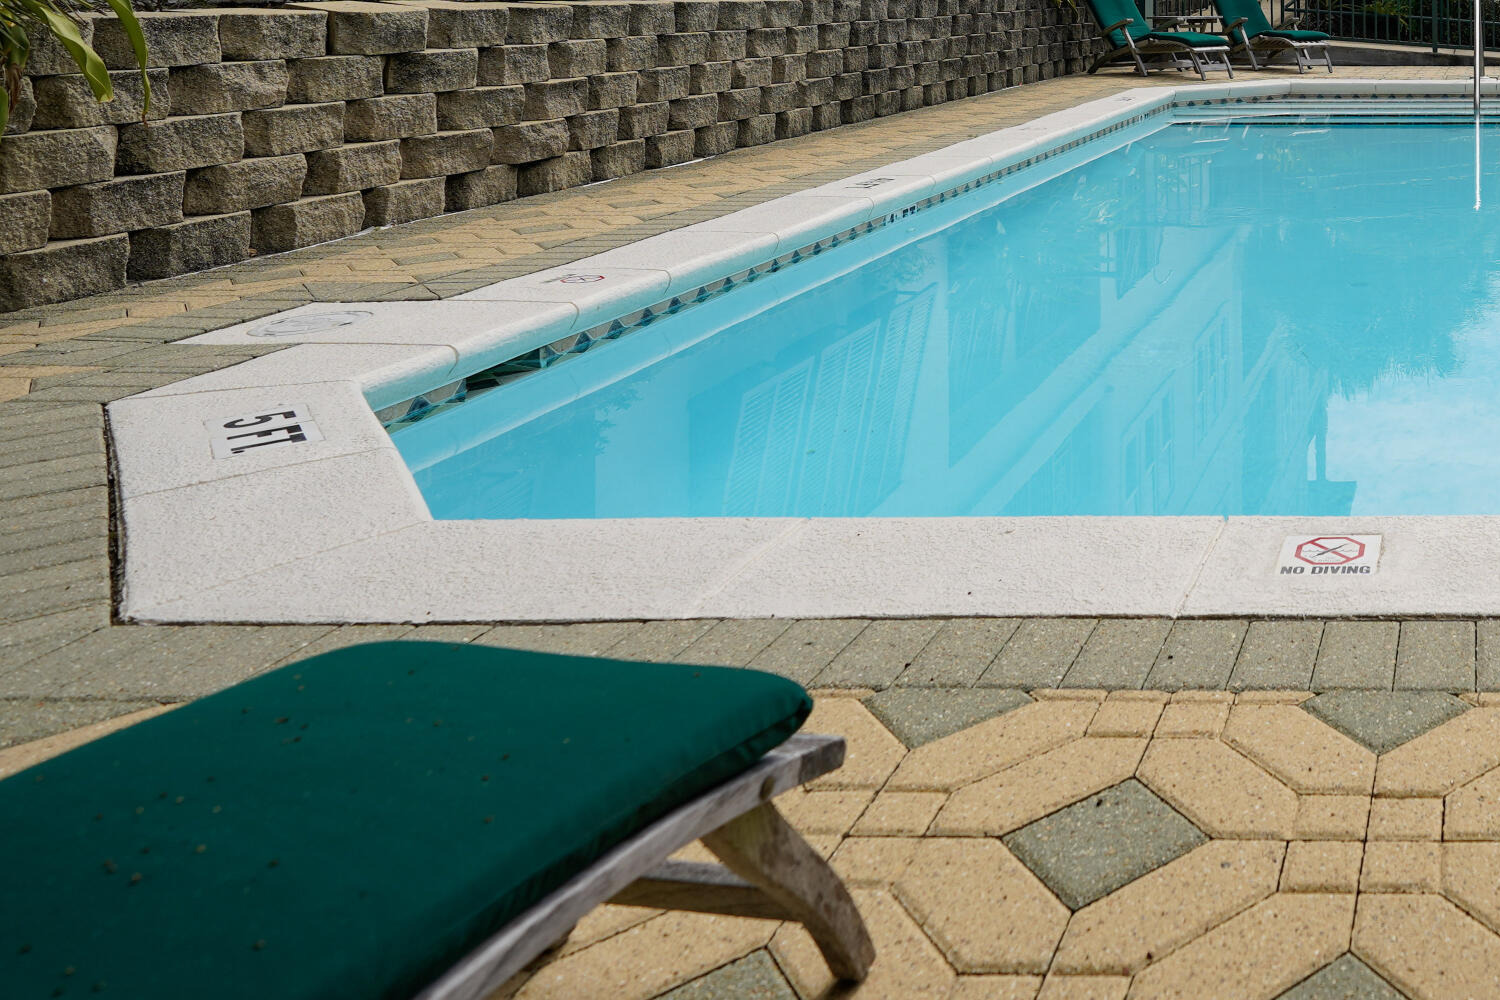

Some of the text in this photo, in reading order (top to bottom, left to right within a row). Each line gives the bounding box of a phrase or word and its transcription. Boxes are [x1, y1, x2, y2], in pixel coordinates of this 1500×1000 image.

[223, 410, 297, 429] 5
[1280, 565, 1371, 575] NO DIVING
